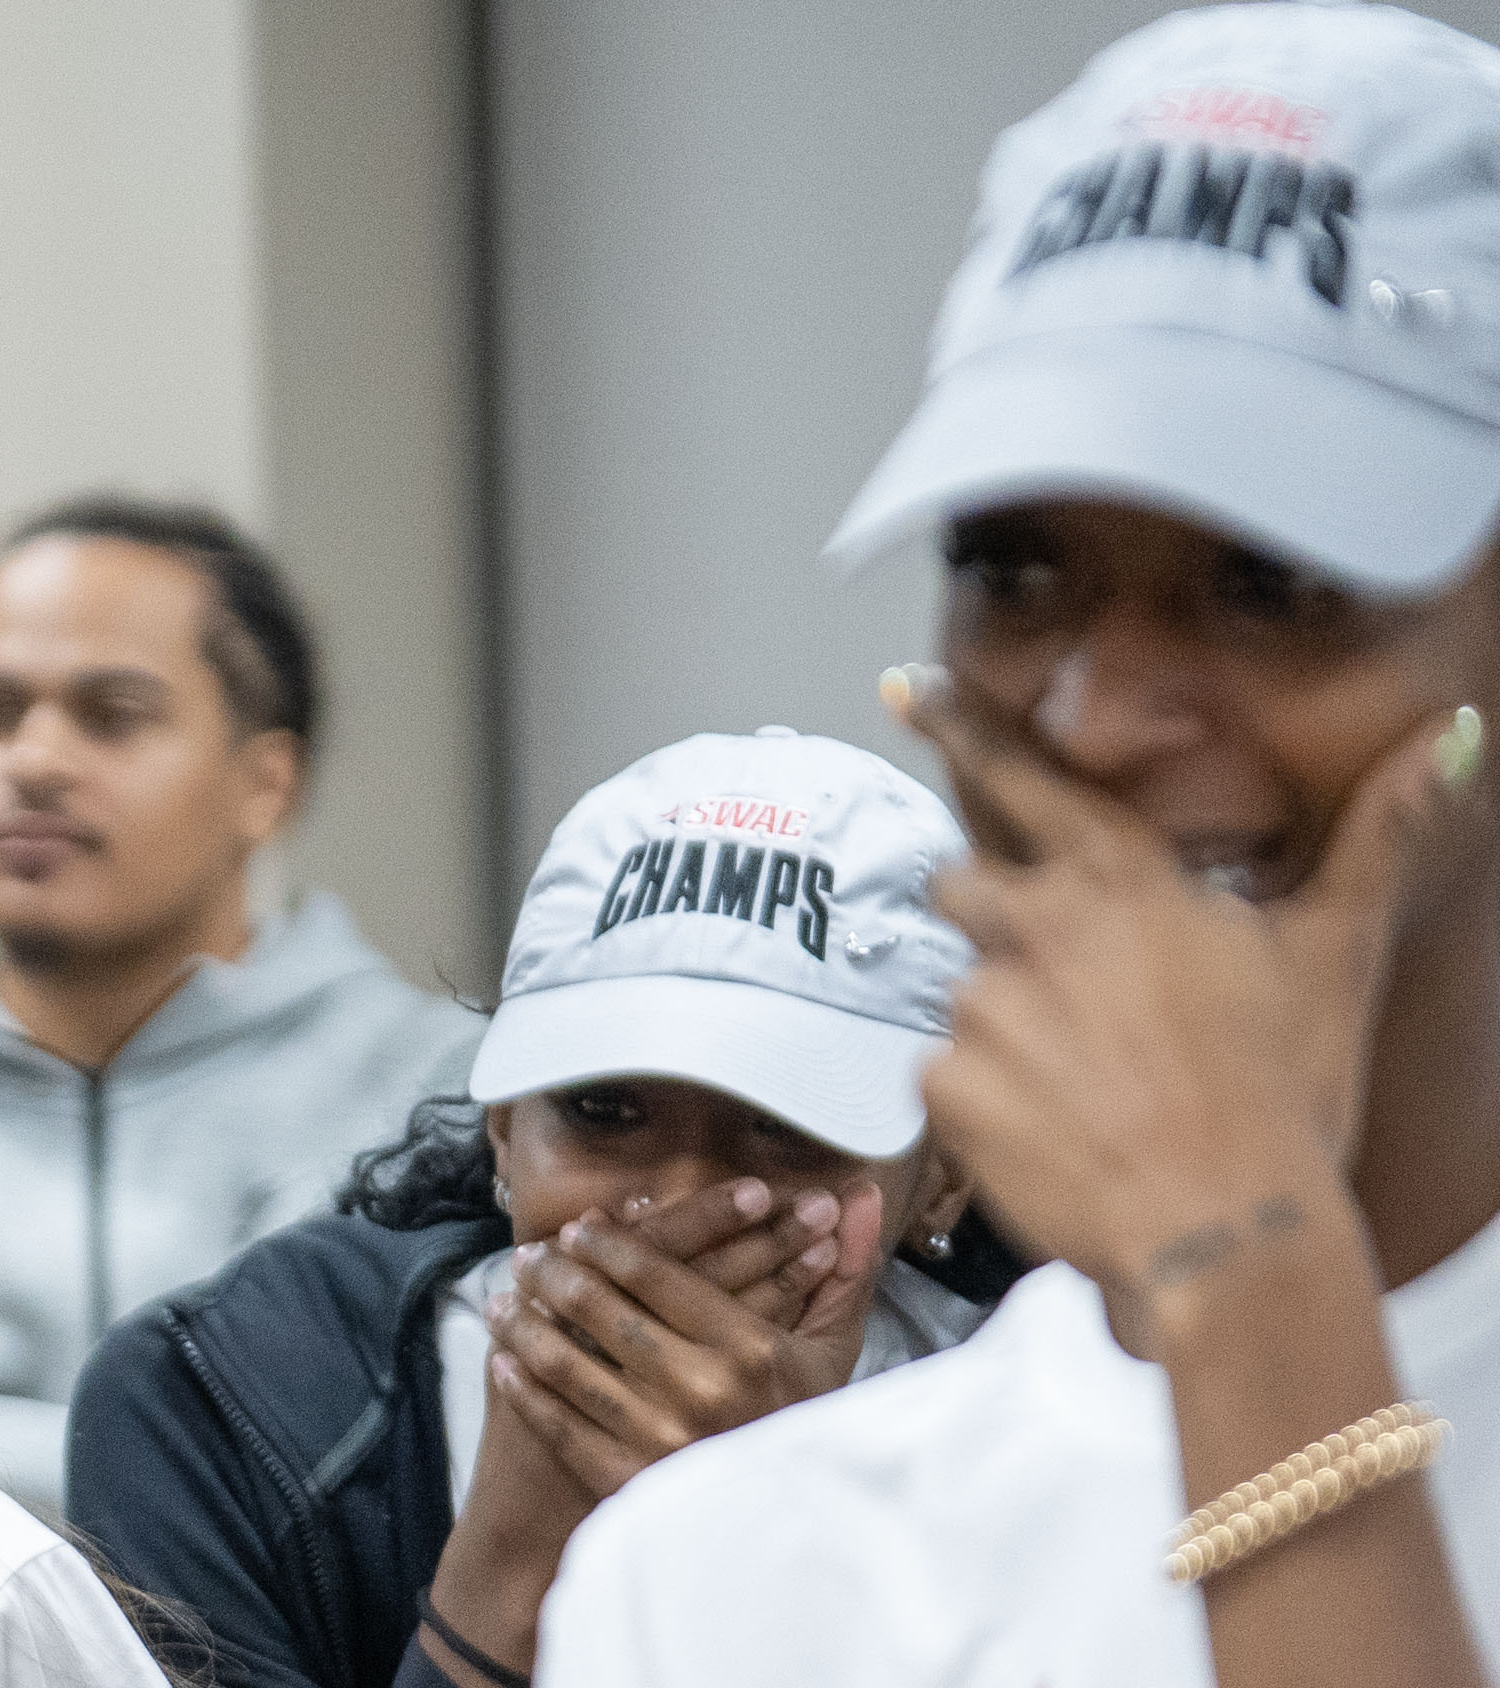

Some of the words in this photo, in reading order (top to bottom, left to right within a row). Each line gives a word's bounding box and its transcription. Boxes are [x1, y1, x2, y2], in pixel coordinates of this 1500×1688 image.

[998, 142, 1357, 311] CHAMPS
[685, 799, 808, 838] SWAC
[592, 837, 836, 963] CHAMPS
